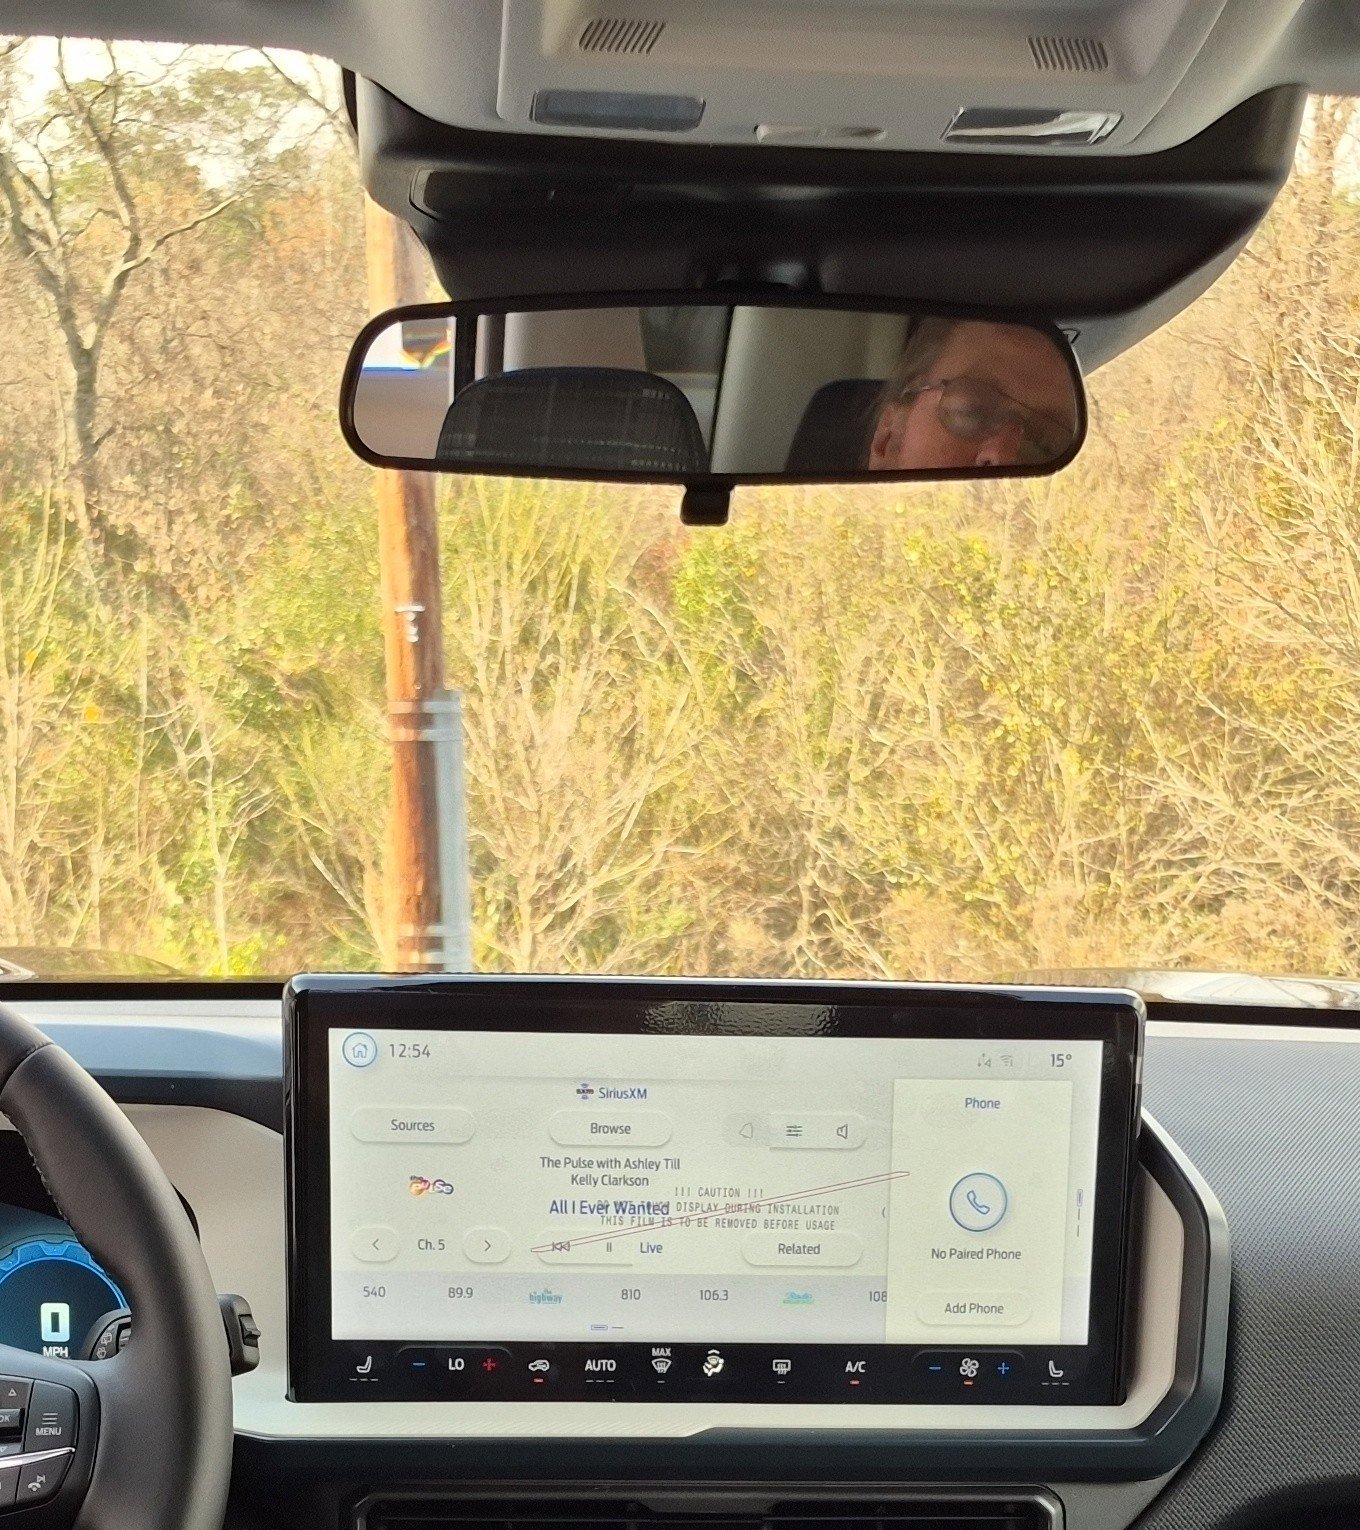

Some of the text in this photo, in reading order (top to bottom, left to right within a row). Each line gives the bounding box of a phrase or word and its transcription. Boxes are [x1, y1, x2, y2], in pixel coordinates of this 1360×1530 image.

[390, 1043, 431, 1058] 12:54
[1050, 1053, 1073, 1068] 15°
[598, 1087, 648, 1099] SiriusXM
[965, 1097, 1001, 1109] Phone
[391, 1119, 435, 1132] Sources
[590, 1122, 631, 1134] Browse
[540, 1156, 681, 1172] The Pulse with Ashley Till
[571, 1174, 649, 1187] Kelly Clarkson
[698, 1187, 740, 1198] CAUTION
[549, 1200, 670, 1216] All I Ever Wanted
[676, 1201, 719, 1213] DISPLAY
[725, 1203, 762, 1214] DURING
[768, 1204, 840, 1216] INSTALLATION
[600, 1215, 836, 1230] THIS FILM IS TO BE REMOVED BEFORE USAGE
[417, 1239, 445, 1251] Ch. 5
[640, 1242, 663, 1253] Live
[778, 1243, 821, 1254] Related
[931, 1248, 1022, 1260] No Paired Phone
[363, 1286, 386, 1298] 540
[448, 1287, 473, 1298] 89.9
[621, 1289, 641, 1300] 810
[700, 1289, 729, 1301] 106.3
[944, 1303, 1004, 1314] Add Phone
[40, 1302, 70, 1343] 0
[42, 1345, 69, 1358] MPH
[652, 1348, 671, 1357] MAX
[448, 1358, 464, 1371] LO
[585, 1359, 616, 1371] AUTO
[845, 1360, 866, 1373] A/C
[35, 1426, 62, 1437] MENU
